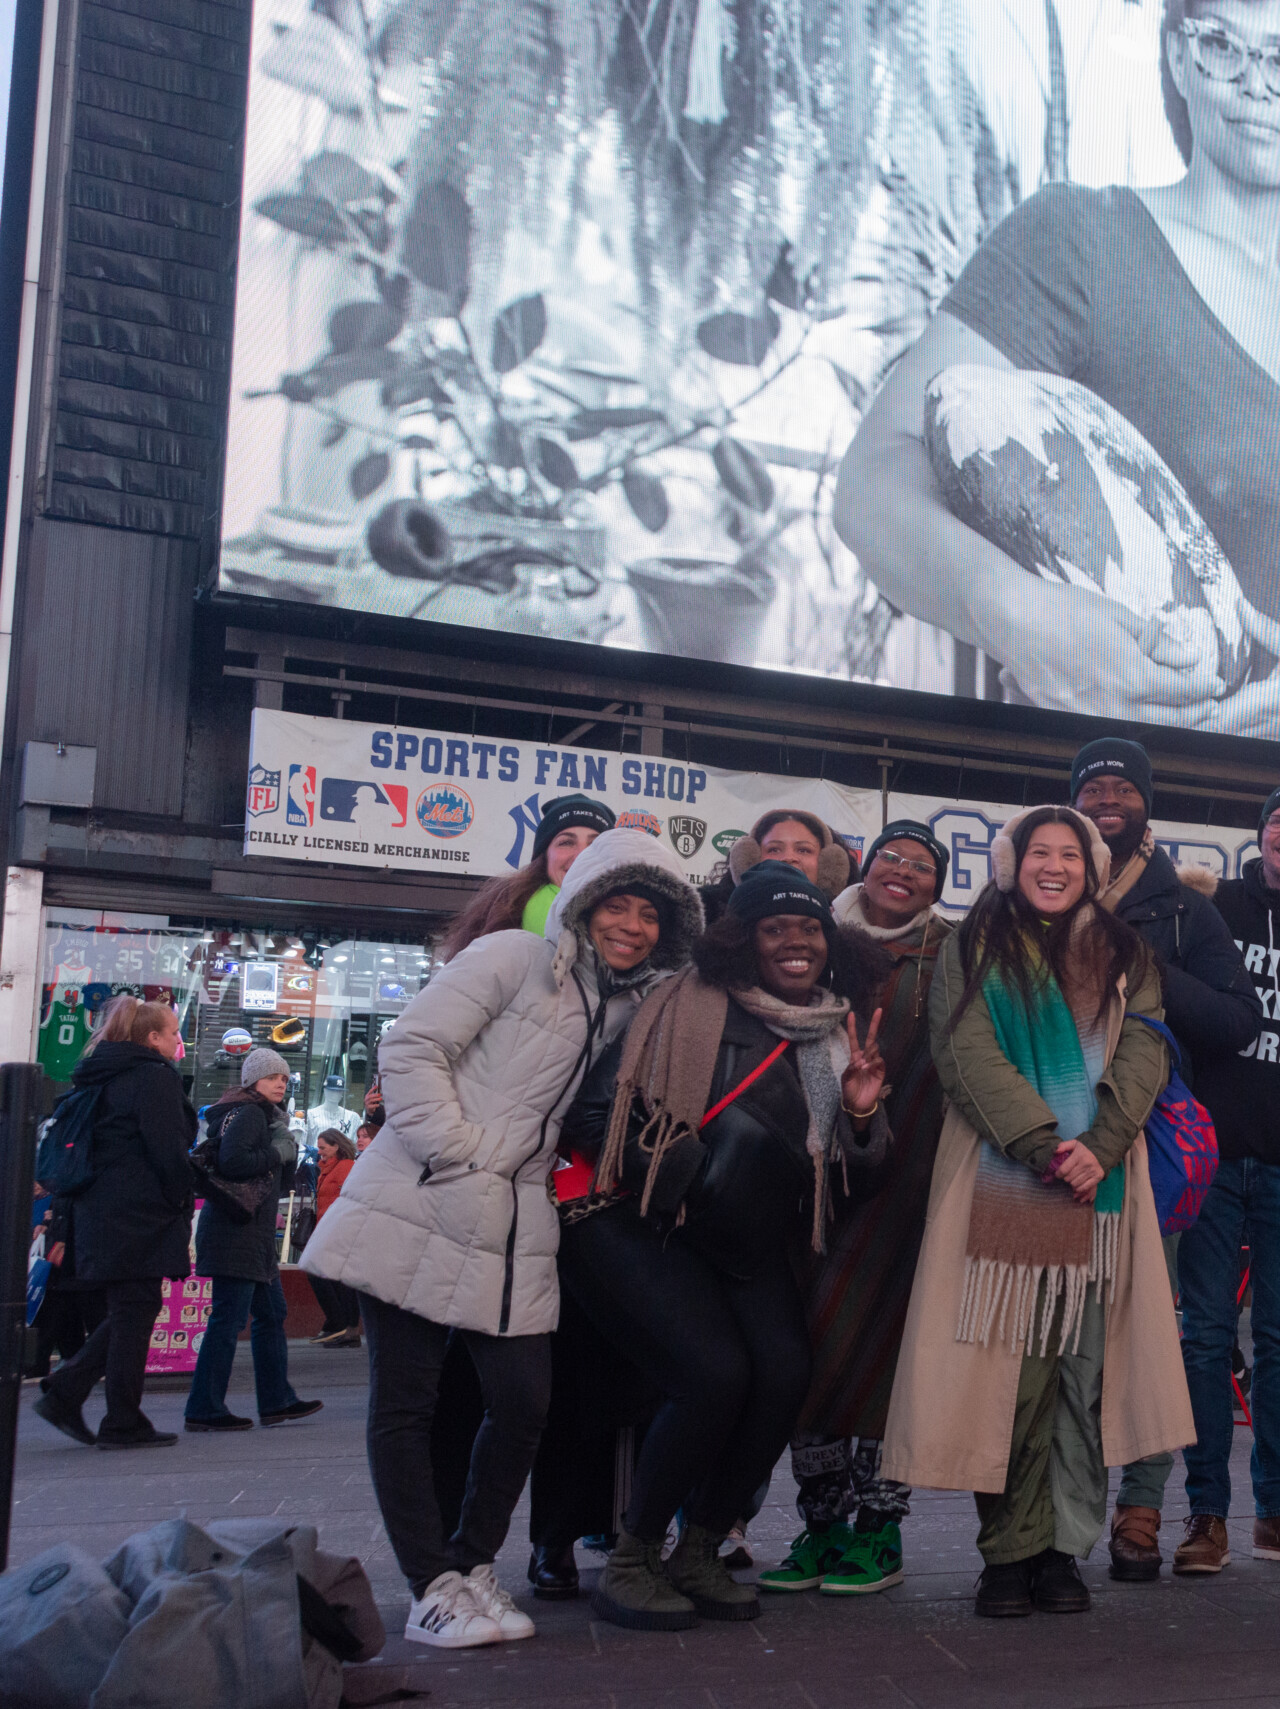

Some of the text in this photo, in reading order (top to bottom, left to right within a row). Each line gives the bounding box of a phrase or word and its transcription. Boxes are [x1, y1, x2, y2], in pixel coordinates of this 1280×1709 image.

[370, 731, 707, 804] SPORTS FAN SHOP
[288, 813, 305, 824] NBA
[424, 803, 464, 823] Mets
[615, 812, 662, 835] KNICKS
[671, 818, 704, 838] NETS
[304, 836, 369, 853] LICENSED
[374, 844, 470, 862] MERCHANDISE
[683, 837, 690, 853] B
[773, 891, 810, 901] ART TAKES
[115, 949, 144, 971] 35
[162, 955, 180, 974] 34
[59, 1014, 79, 1023] TATUM
[58, 1024, 75, 1046] 0
